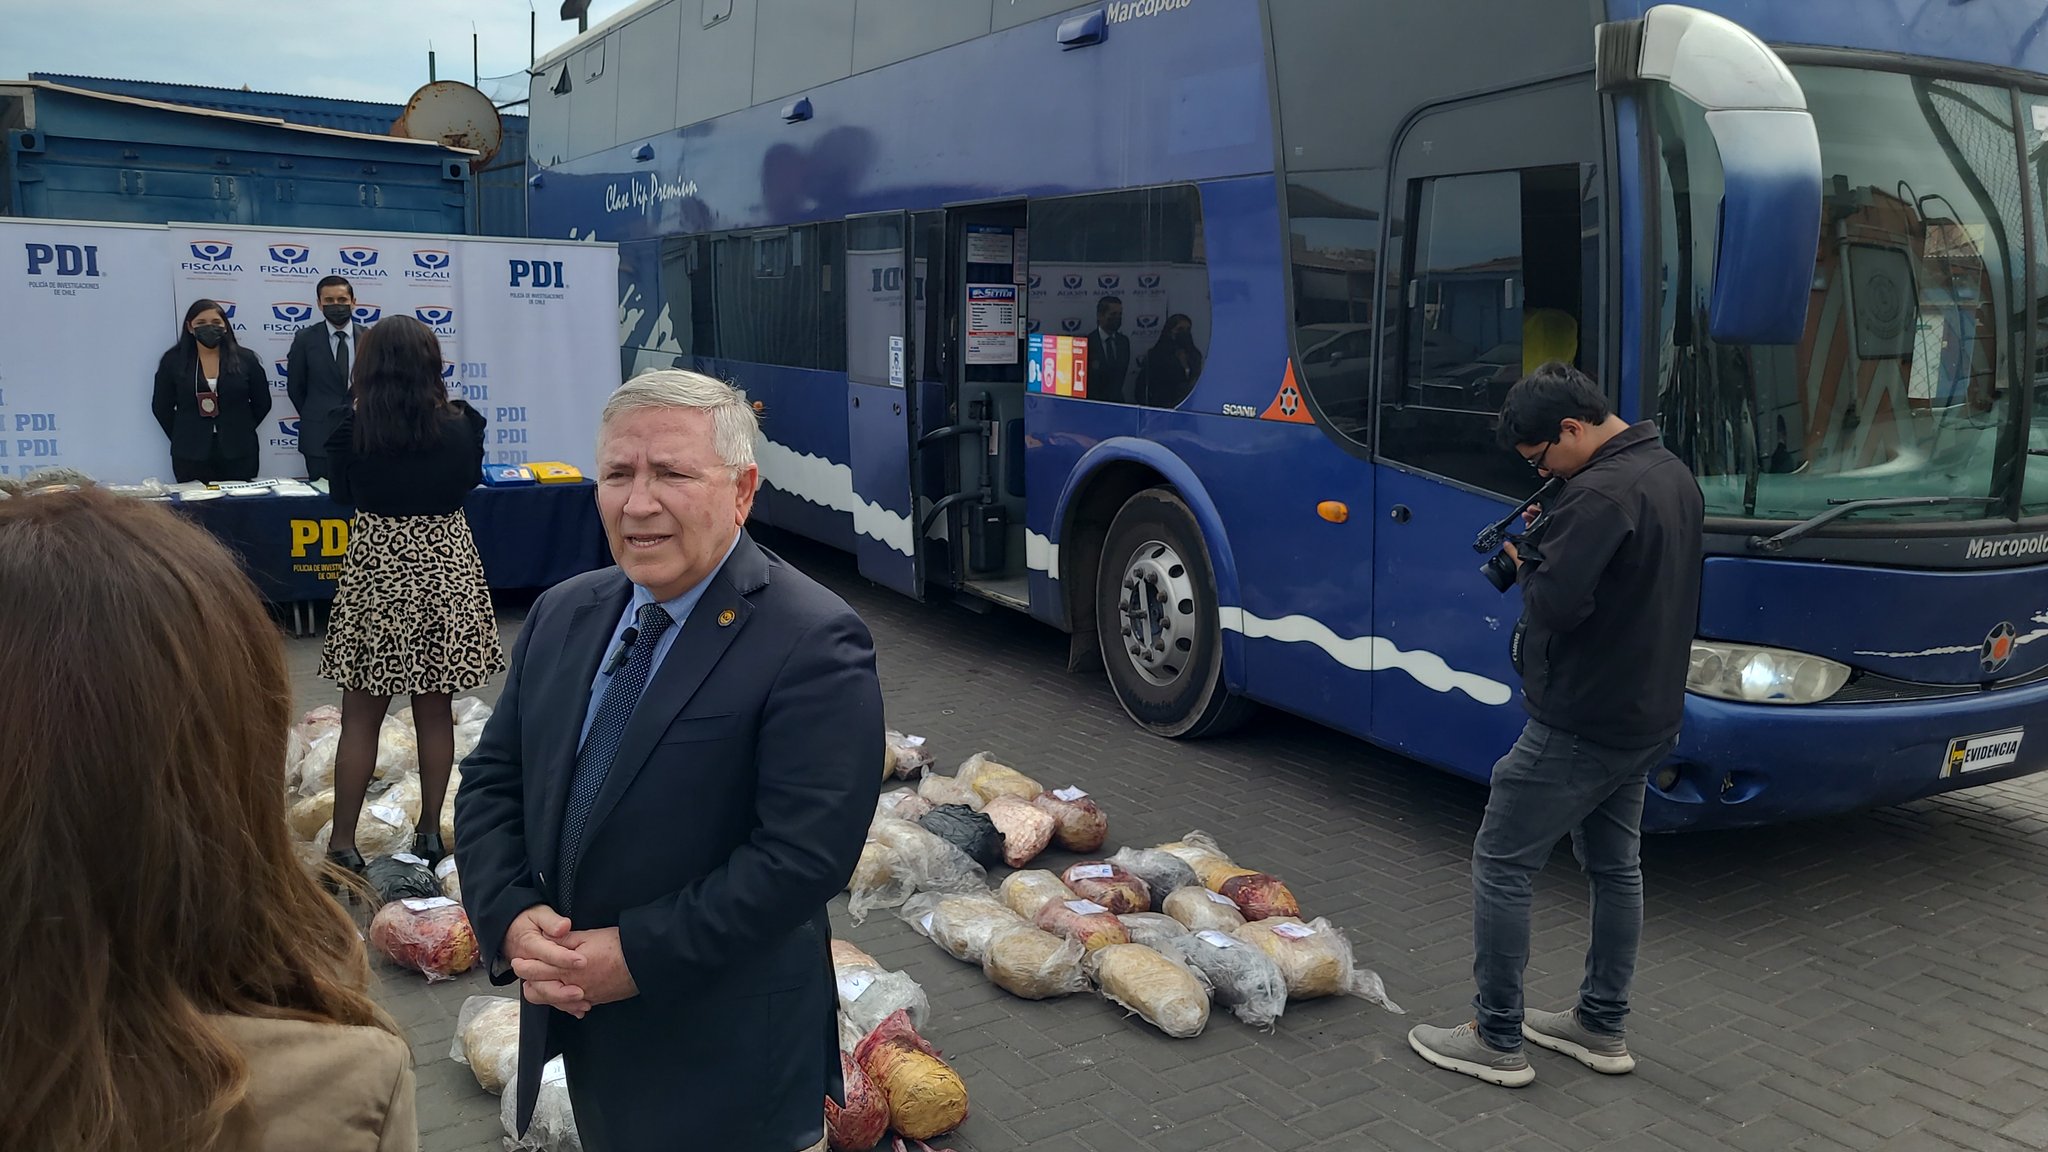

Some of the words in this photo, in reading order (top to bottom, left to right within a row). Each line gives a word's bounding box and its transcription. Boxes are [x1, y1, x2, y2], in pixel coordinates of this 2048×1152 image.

[605, 182, 629, 213] Clase
[631, 177, 648, 216] Vip
[650, 173, 698, 206] Premium
[25, 243, 100, 276] PDI
[181, 262, 244, 272] FISCALIA
[260, 265, 320, 274] FISCALIA
[331, 267, 389, 277] FISCALIA
[509, 259, 565, 289] PDI
[57, 282, 100, 290] INVESTIGACIONES
[15, 413, 56, 432] PDI
[496, 406, 526, 422] PDI
[497, 428, 527, 444] PDI
[17, 438, 58, 457] PDI
[498, 449, 528, 465] PDI
[290, 518, 355, 557] PD
[1965, 534, 2048, 559] Marcopolo
[1964, 740, 2019, 763] EVIDENCIA
